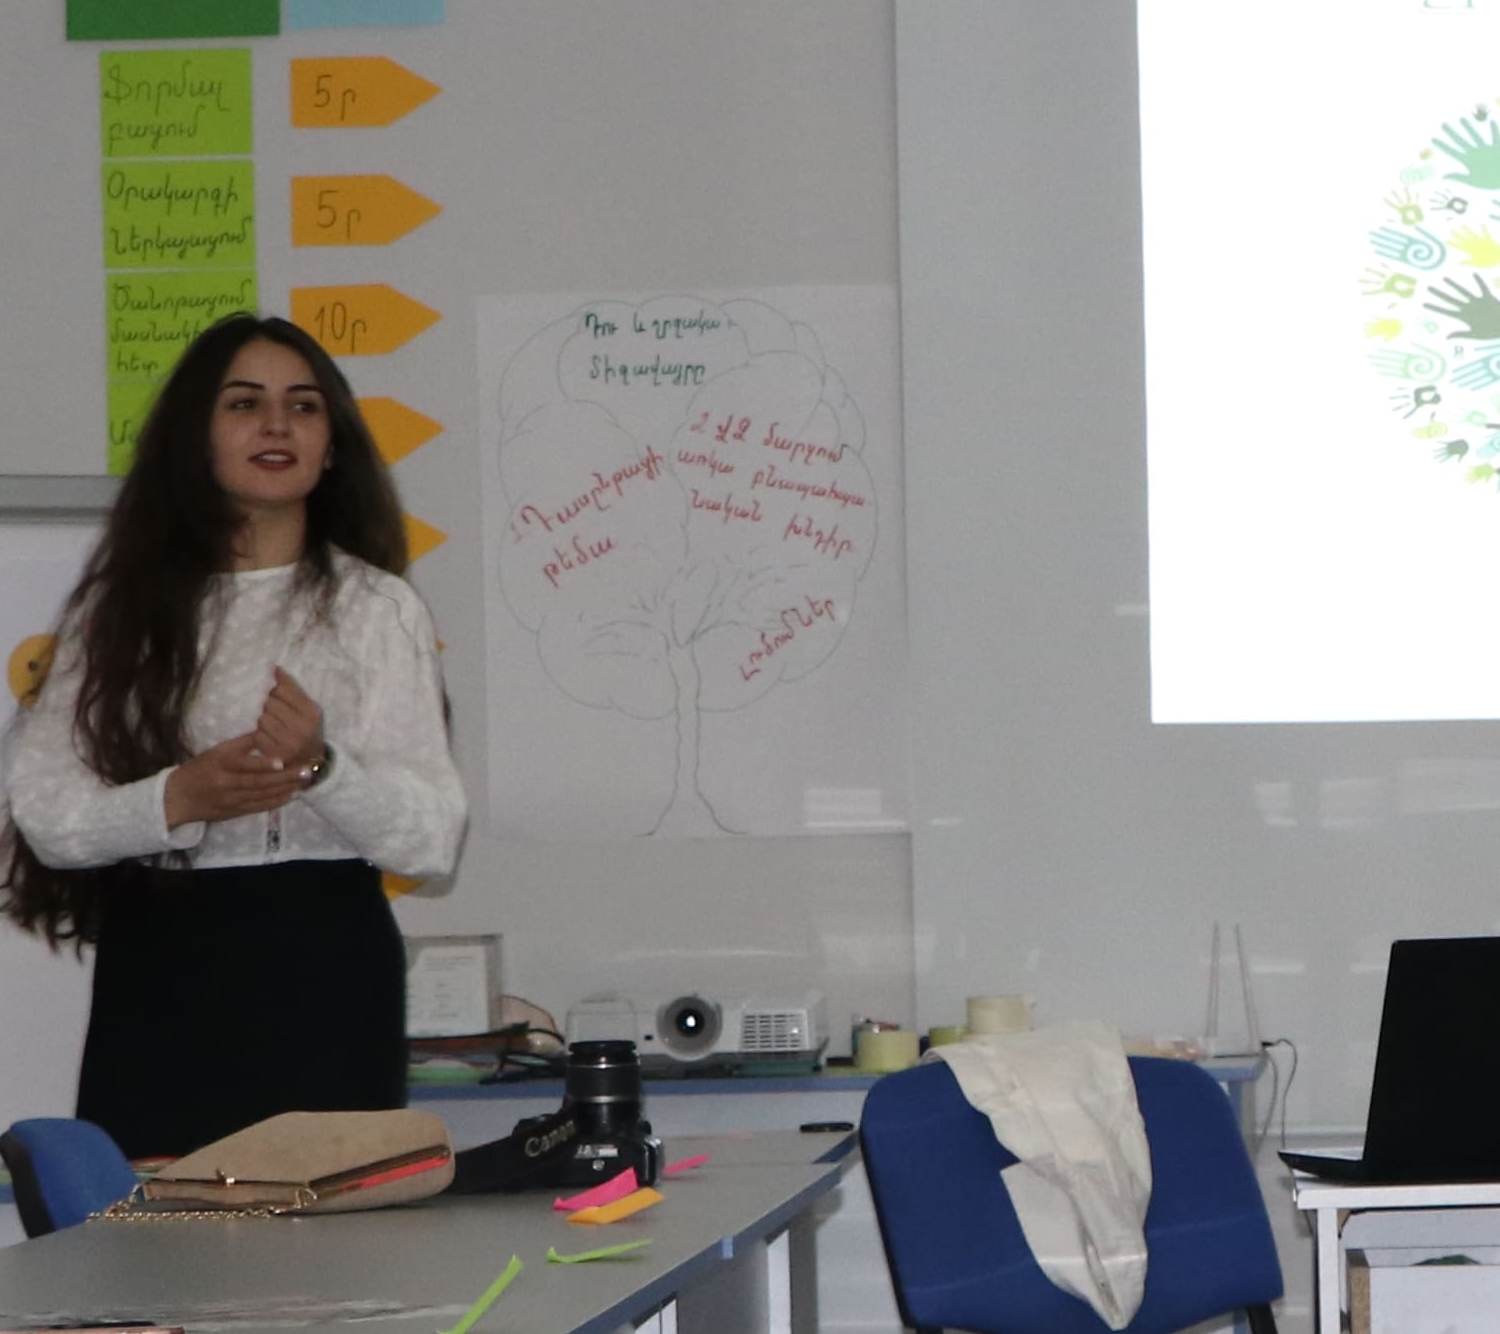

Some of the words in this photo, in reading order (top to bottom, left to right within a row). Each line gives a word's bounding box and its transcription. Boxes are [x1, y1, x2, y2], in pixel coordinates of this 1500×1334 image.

[104, 60, 232, 117] Ֆորմալ
[108, 104, 206, 156] բացում
[107, 171, 238, 216] Օրակարգի
[113, 279, 252, 319] Ծանոթացում
[585, 313, 618, 339] Դու
[651, 309, 721, 340] շրջակա
[589, 354, 706, 386] միջավայրը
[677, 447, 735, 477] առկա
[783, 512, 854, 560] խնդիր
[542, 534, 619, 588] թեմա
[739, 594, 836, 681] Լուծումներ
[525, 1119, 577, 1158] Canon
